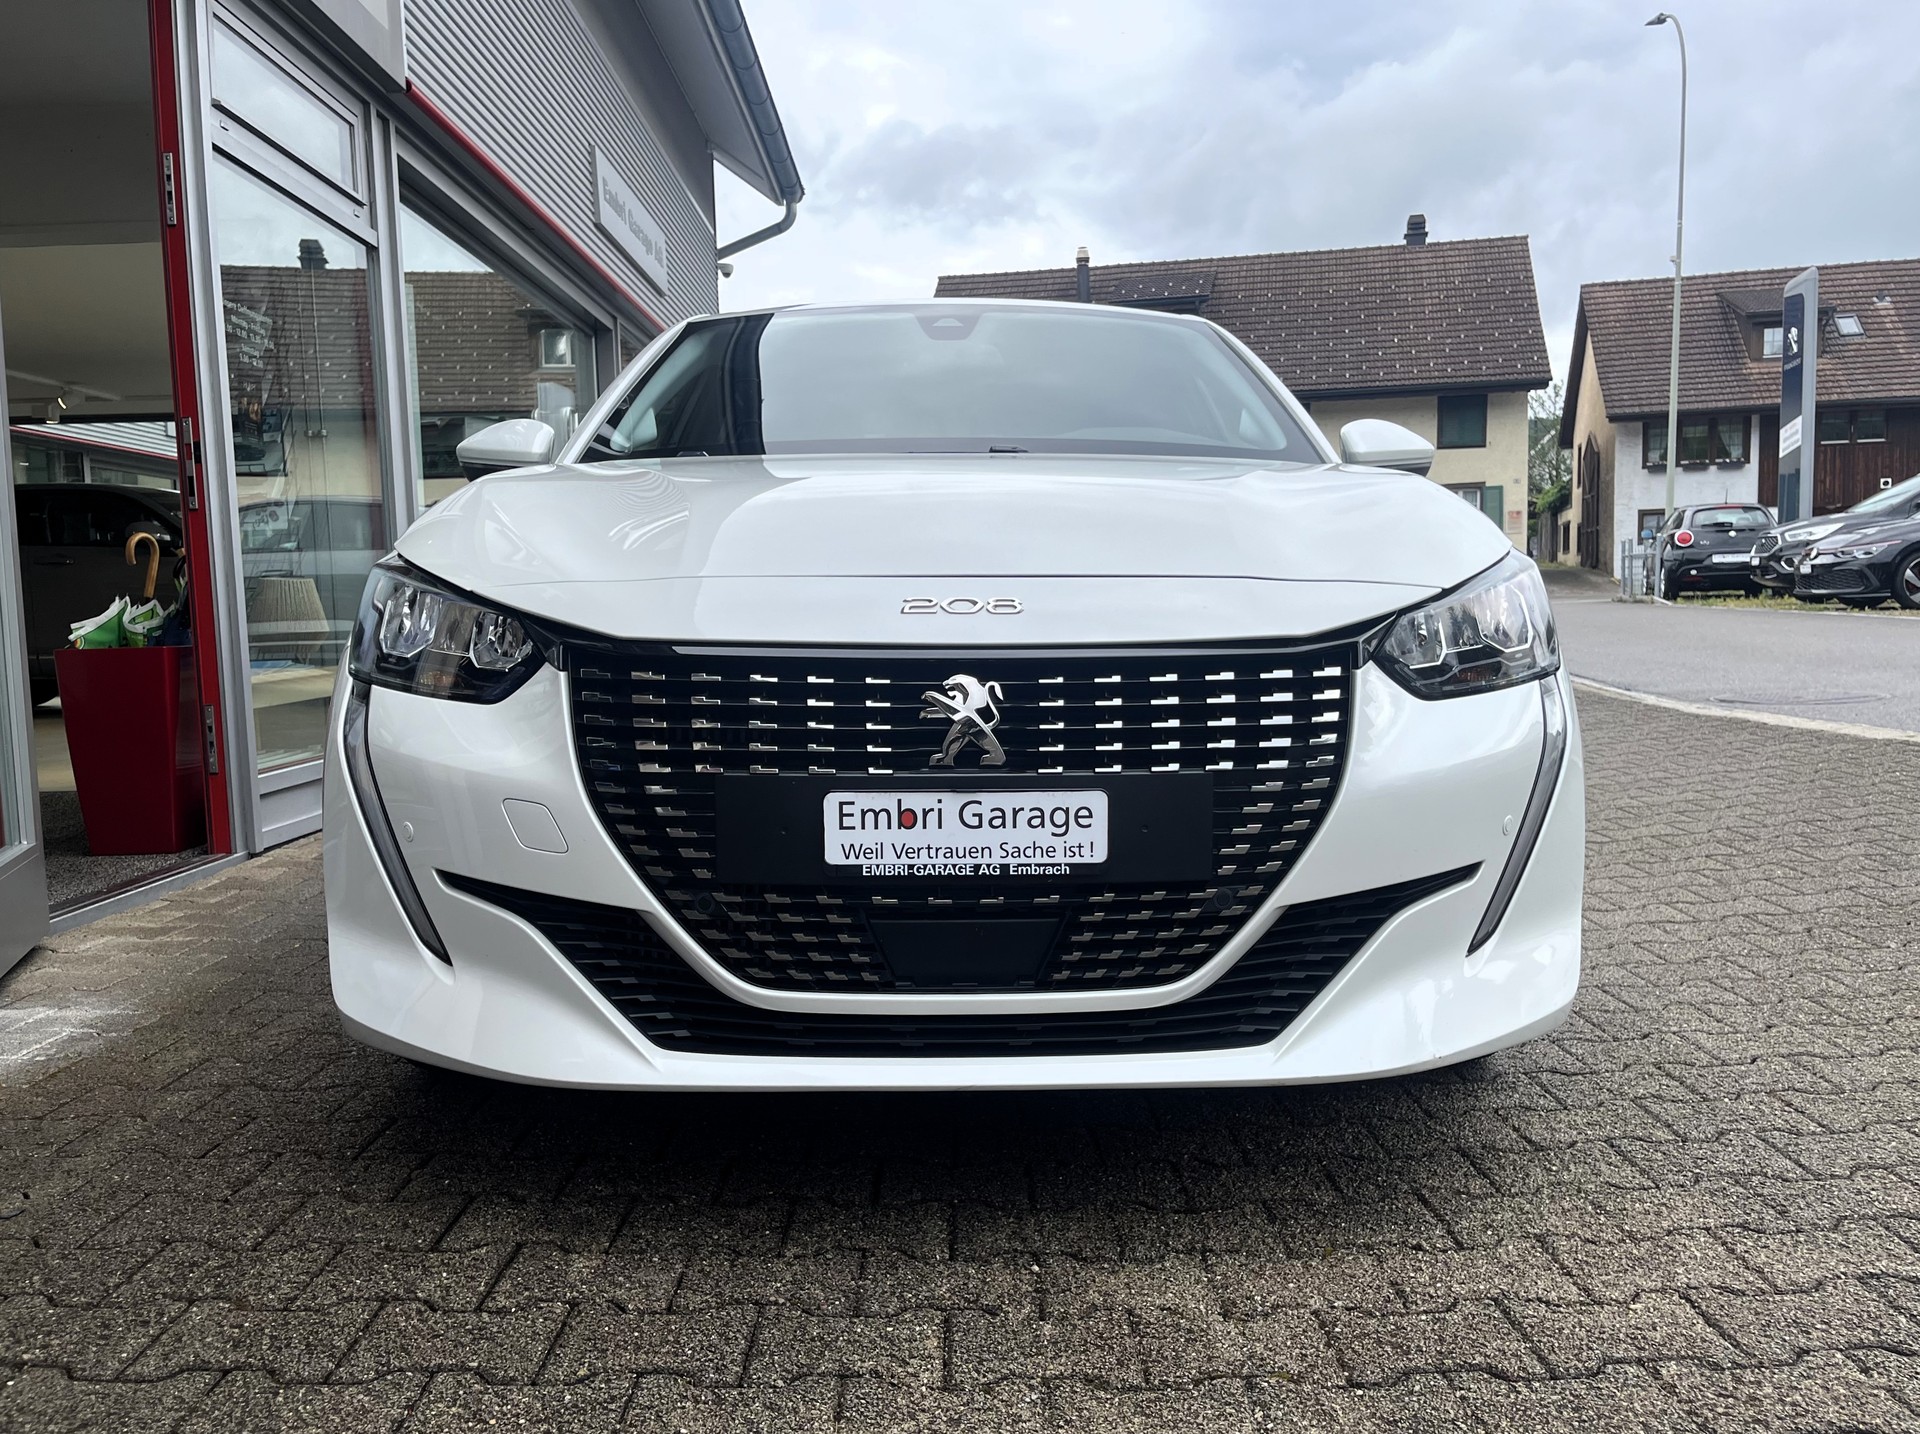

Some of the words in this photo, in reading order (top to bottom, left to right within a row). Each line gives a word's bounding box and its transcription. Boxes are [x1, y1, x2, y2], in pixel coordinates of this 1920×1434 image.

[900, 597, 1024, 614] 208
[838, 798, 943, 830] Embri
[958, 799, 1094, 837] Garage
[841, 842, 884, 860] Weil
[892, 842, 992, 860] Vertrauen
[1000, 841, 1057, 859] Sache
[862, 864, 975, 876] EMBRI-GARAGE
[978, 864, 1000, 876] AG
[1009, 863, 1070, 875] Embrach
